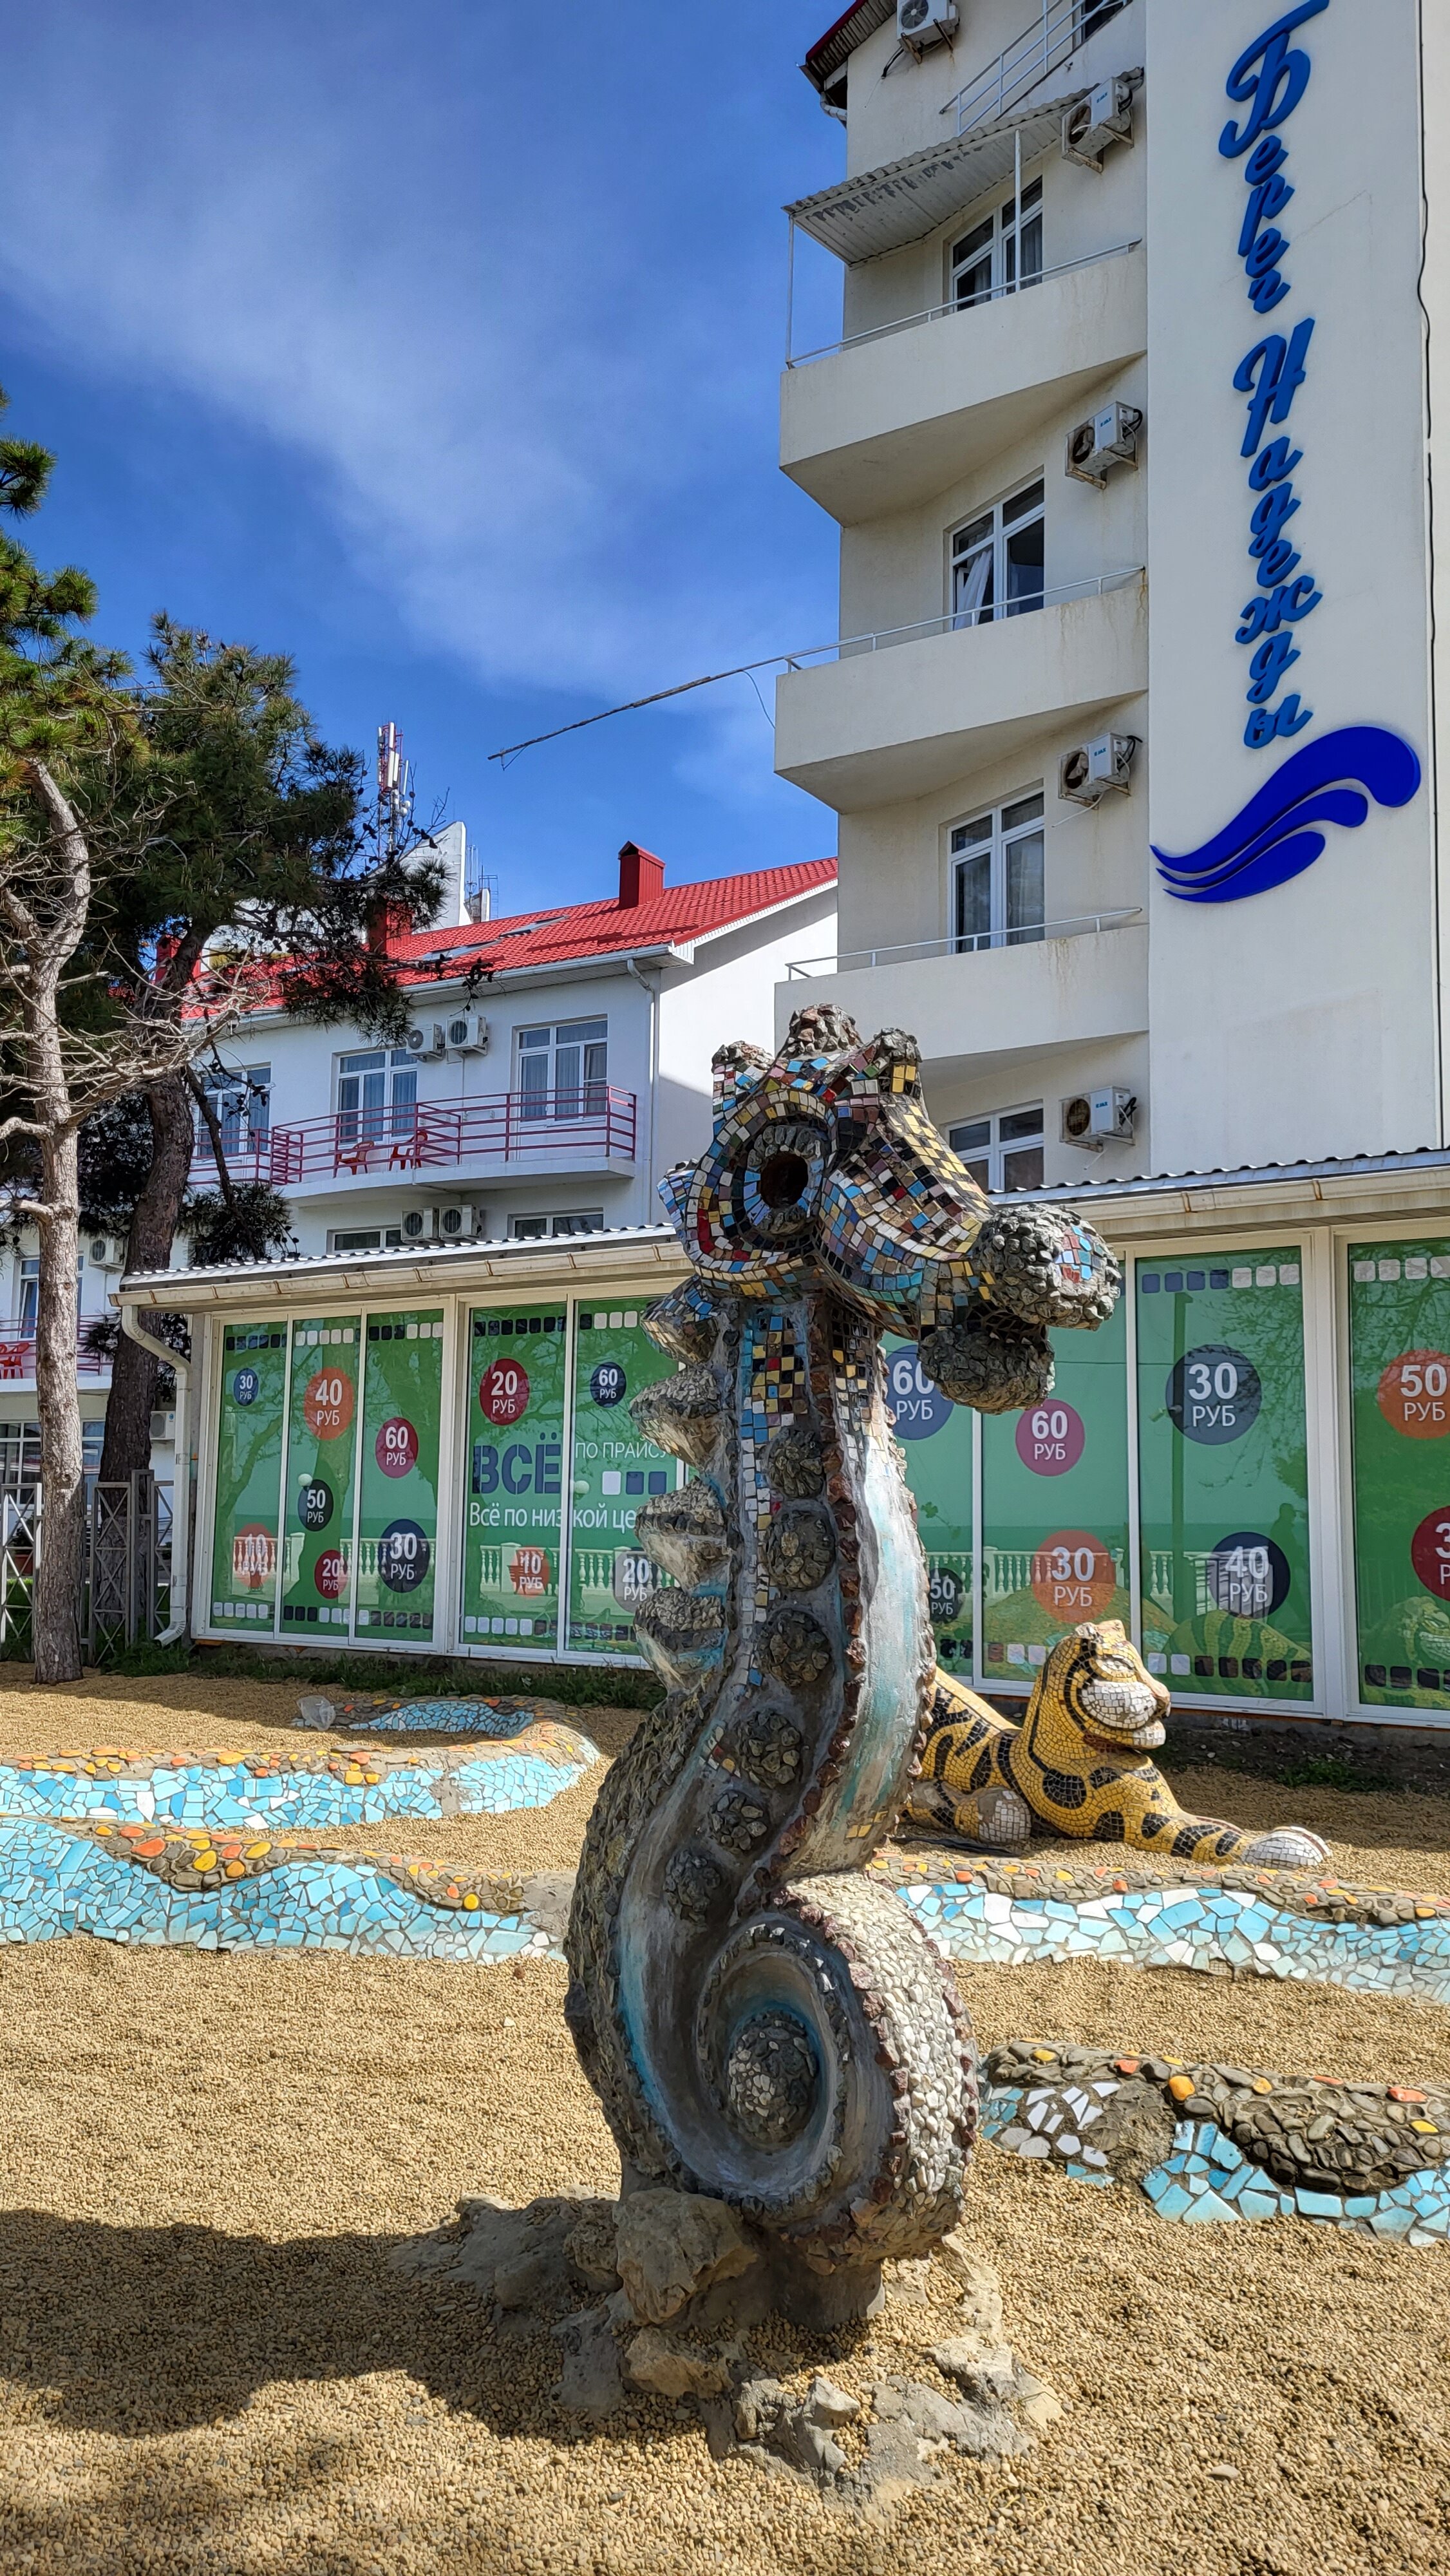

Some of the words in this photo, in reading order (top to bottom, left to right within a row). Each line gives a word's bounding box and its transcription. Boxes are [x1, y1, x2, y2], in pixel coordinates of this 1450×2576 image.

[1218, 0, 1329, 314] Берег
[1232, 317, 1323, 749] Надежды
[239, 1376, 253, 1390] 30
[491, 1370, 517, 1396] 20
[598, 1368, 617, 1387] 60
[893, 1360, 934, 1395] 60
[1188, 1362, 1238, 1401] 30
[1400, 1363, 1447, 1397] 50
[239, 1391, 252, 1400] РУБ
[315, 1379, 343, 1406] 40
[599, 1388, 617, 1398] РУБ
[493, 1399, 515, 1414] РУБ
[896, 1399, 933, 1420] РУБ
[1192, 1405, 1236, 1426] РУБ
[1404, 1402, 1445, 1421] РУБ
[316, 1410, 340, 1426] РУБ
[1031, 1410, 1068, 1439] 60
[386, 1426, 408, 1449] 60
[386, 1452, 407, 1466] РУБ
[1033, 1443, 1066, 1460] РУБ
[471, 1432, 561, 1495] ВСЁ
[576, 1443, 598, 1459] ПО
[306, 1489, 326, 1509] 50
[306, 1511, 325, 1524] РУБ
[469, 1502, 500, 1526] Всё
[504, 1508, 527, 1526] по
[390, 1532, 417, 1560] 30
[1435, 1522, 1450, 1558] 3
[322, 1558, 340, 1577] 20
[390, 1563, 415, 1580] РУБ
[522, 1553, 541, 1575] 10
[622, 1558, 649, 1584] 20
[1051, 1547, 1095, 1582] 30
[1225, 1546, 1269, 1579] 40
[323, 1580, 339, 1591] РУБ
[520, 1577, 542, 1589] РУБ
[930, 1578, 954, 1600] 50
[1230, 1582, 1267, 1604] РУБ
[624, 1587, 647, 1602] РУБ
[1053, 1586, 1092, 1607] РУБ
[931, 1602, 953, 1615] РУБ
